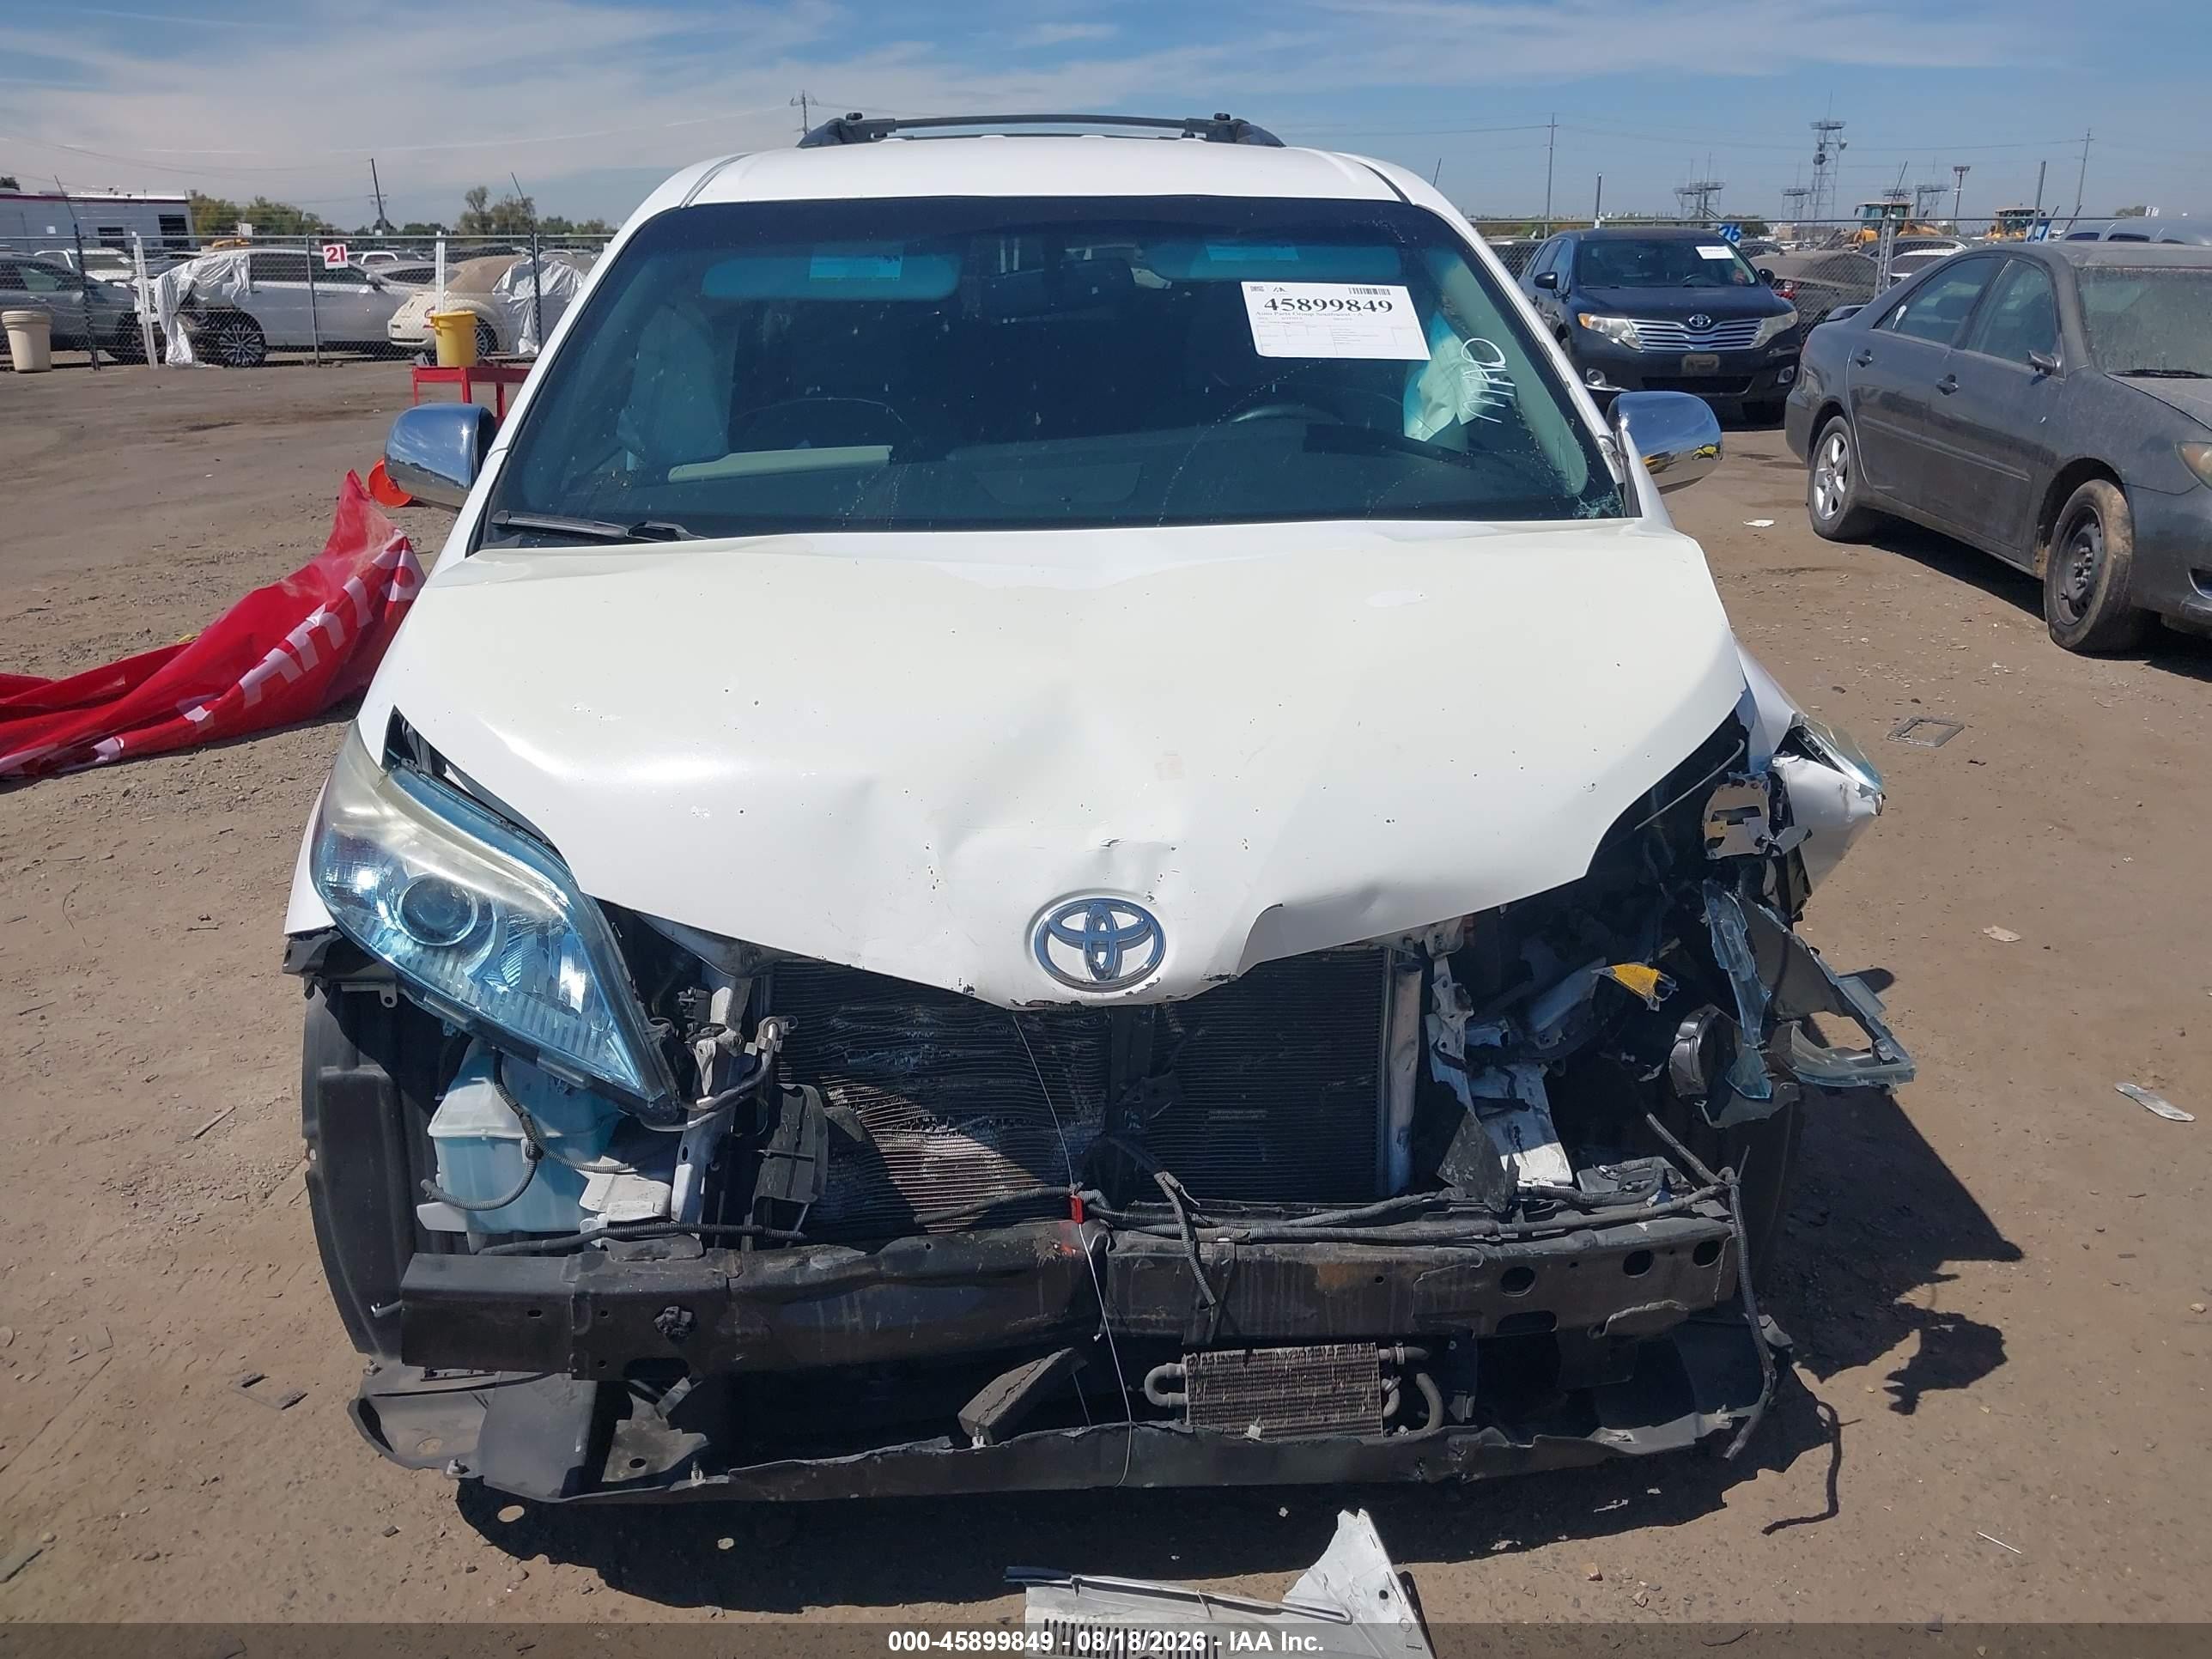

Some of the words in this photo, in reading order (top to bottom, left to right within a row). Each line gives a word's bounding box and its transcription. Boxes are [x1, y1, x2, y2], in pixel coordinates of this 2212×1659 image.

[1718, 223, 1740, 242] 76
[325, 246, 345, 262] 21
[1264, 298, 1393, 313] 45899849
